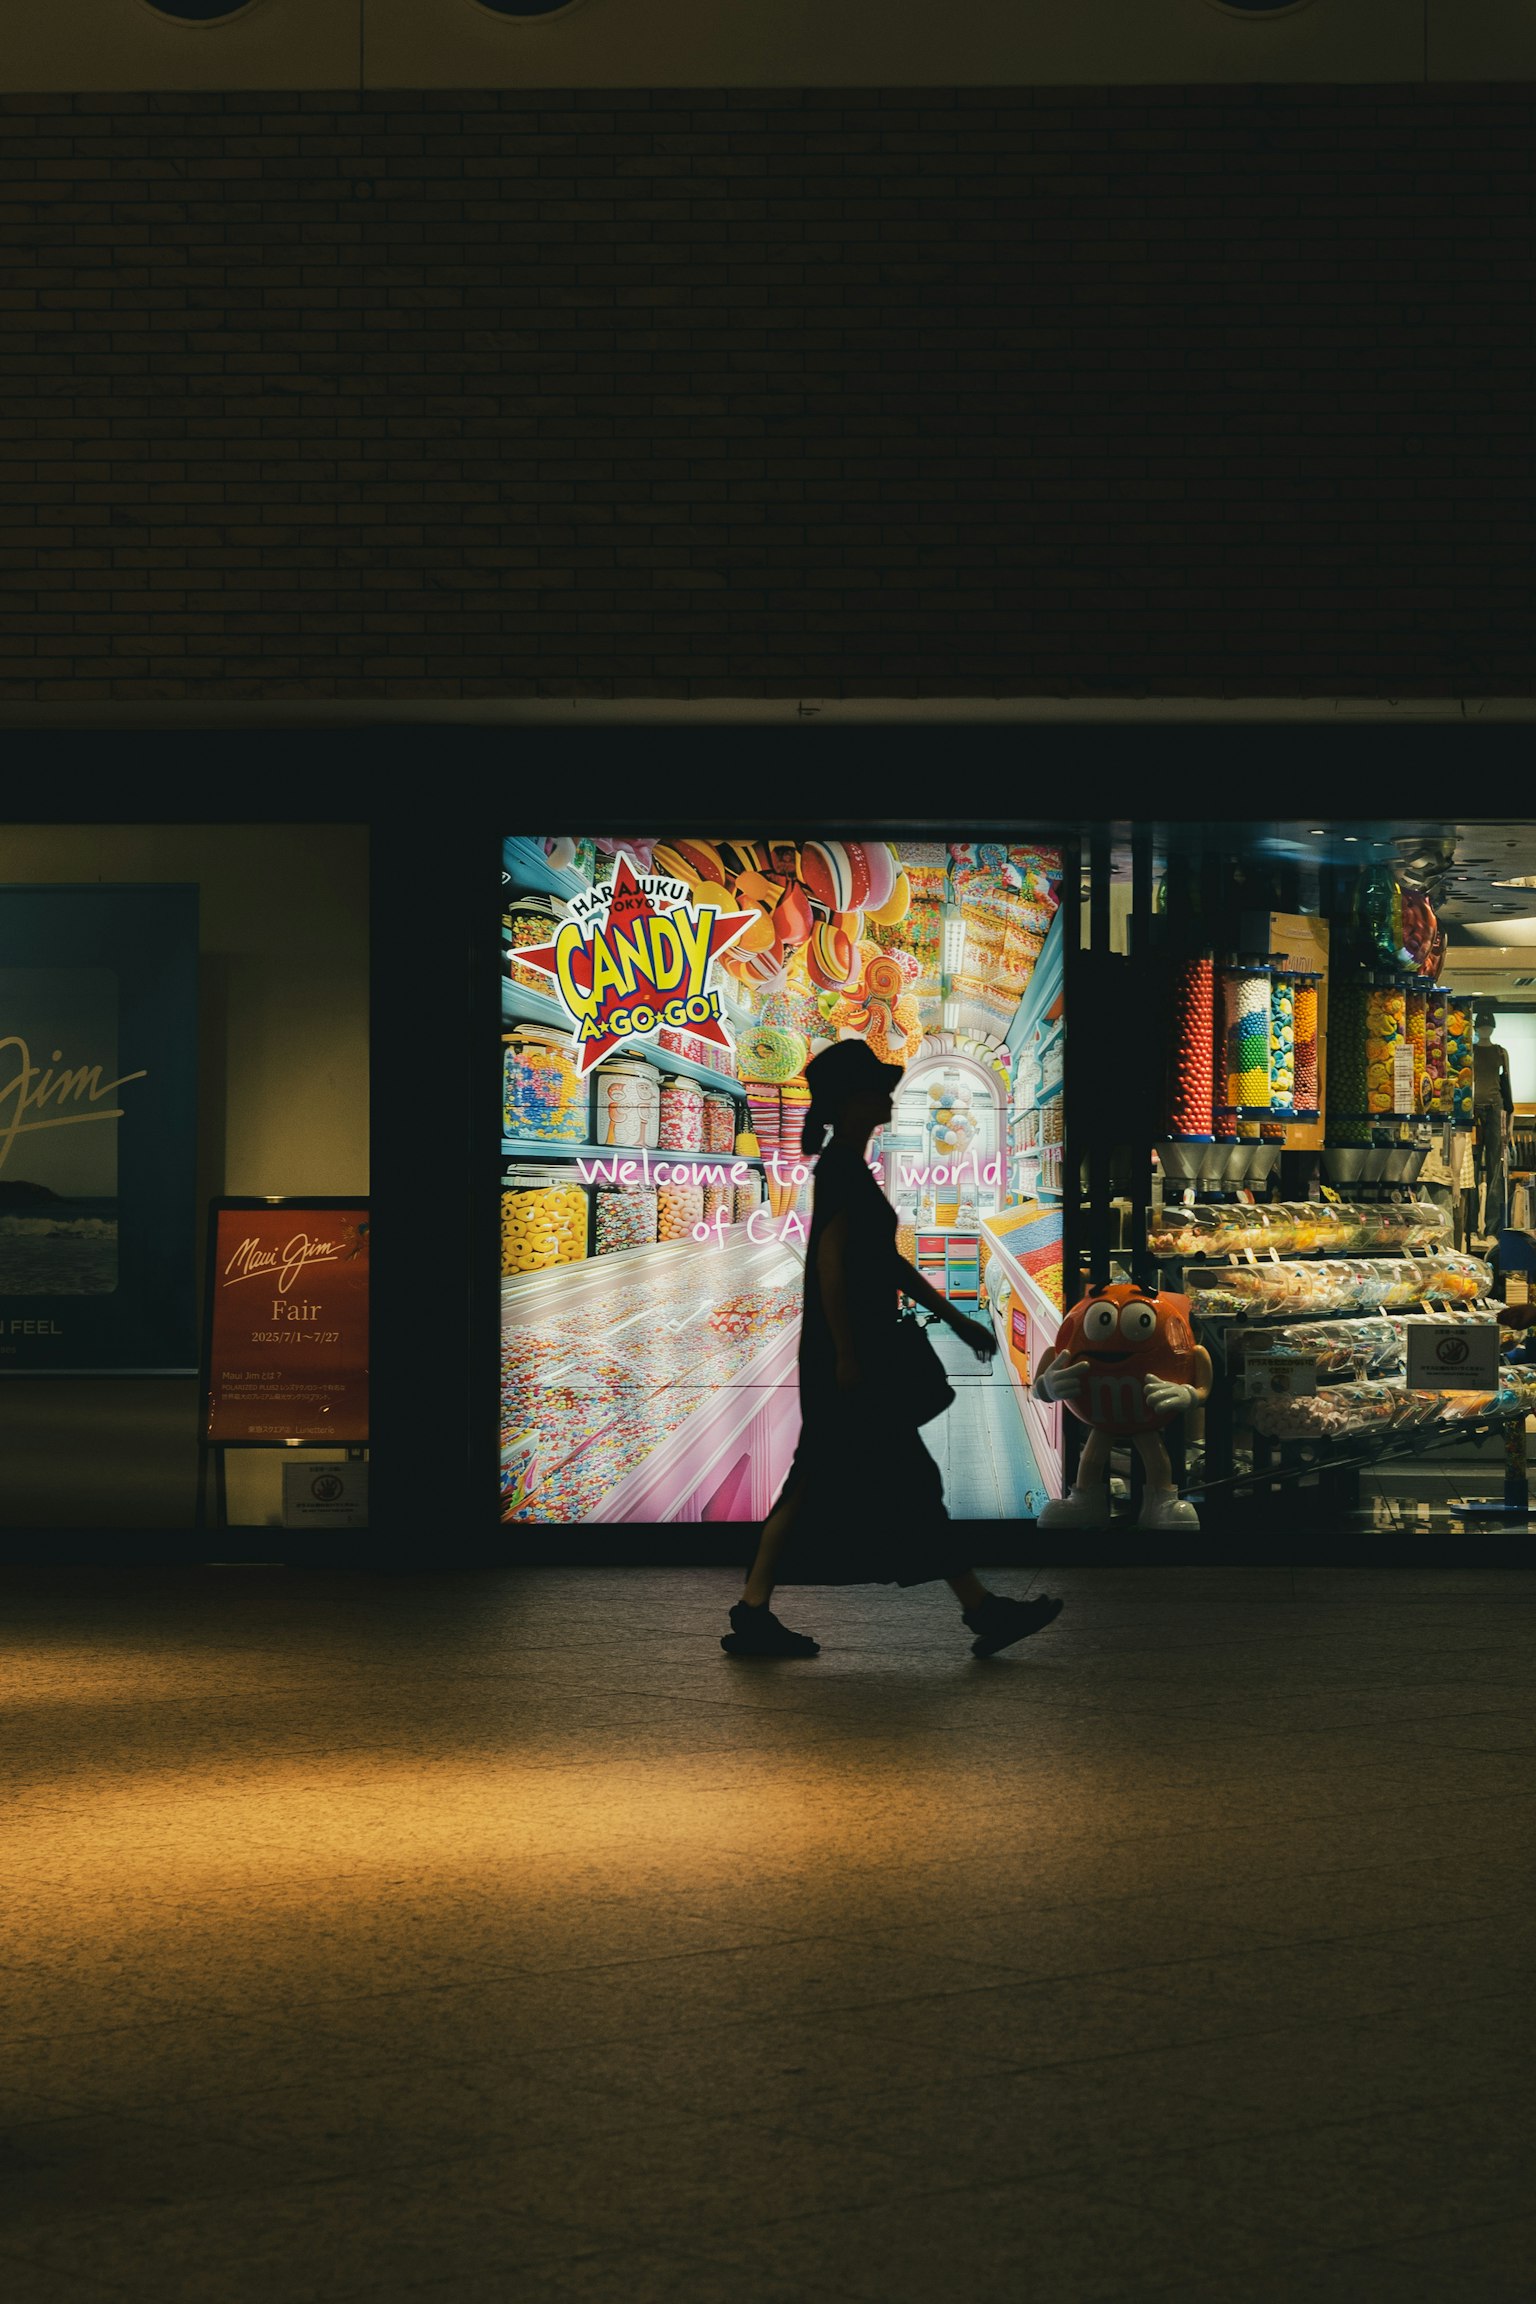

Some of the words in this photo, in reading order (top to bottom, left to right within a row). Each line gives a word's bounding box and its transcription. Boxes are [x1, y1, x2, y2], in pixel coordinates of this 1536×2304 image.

[572, 879, 684, 917] HARAJUKU
[606, 898, 655, 914] TOKYO
[556, 906, 717, 1021] CANDY
[576, 1148, 751, 1186] Welcome
[764, 1150, 810, 1187] to
[900, 1151, 1002, 1187] world
[692, 1205, 730, 1250] of
[224, 1238, 278, 1275] Maui
[279, 1233, 346, 1294] Jim
[11, 1319, 63, 1334] FEEL
[271, 1299, 322, 1321] Fair
[222, 1371, 243, 1380] Maui
[245, 1371, 260, 1380] Jim
[1089, 1376, 1150, 1423] m
